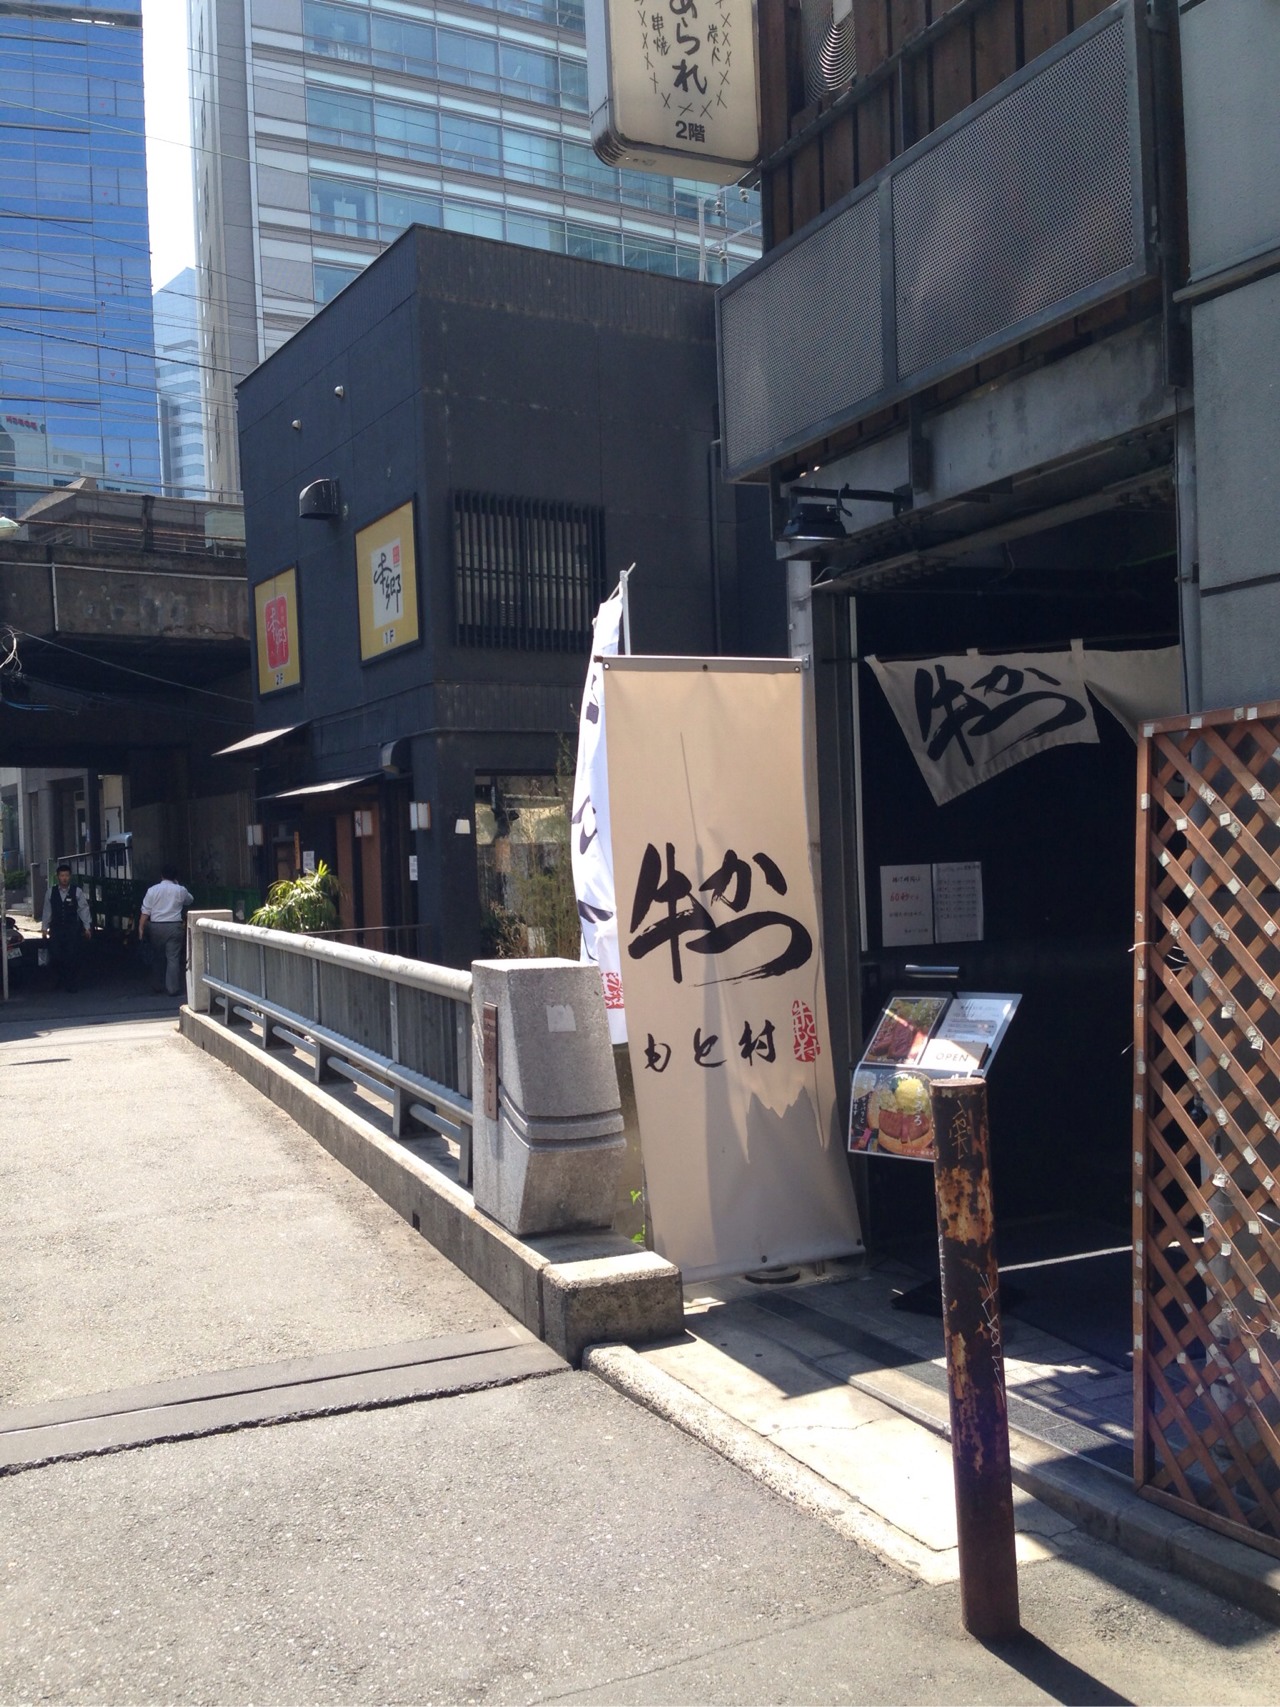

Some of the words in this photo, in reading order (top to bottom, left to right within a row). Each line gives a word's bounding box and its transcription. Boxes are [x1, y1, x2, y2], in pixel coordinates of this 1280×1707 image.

[651, 13, 671, 56] 串焼
[706, 24, 721, 66] 炭火
[675, 120, 706, 143] 2階
[385, 629, 394, 644] 1F
[276, 673, 284, 686] 2F
[914, 664, 1087, 766] 牛かつ
[628, 842, 813, 987] 牛かつ
[644, 1020, 776, 1073] もと村
[936, 1053, 970, 1063] OPEN
